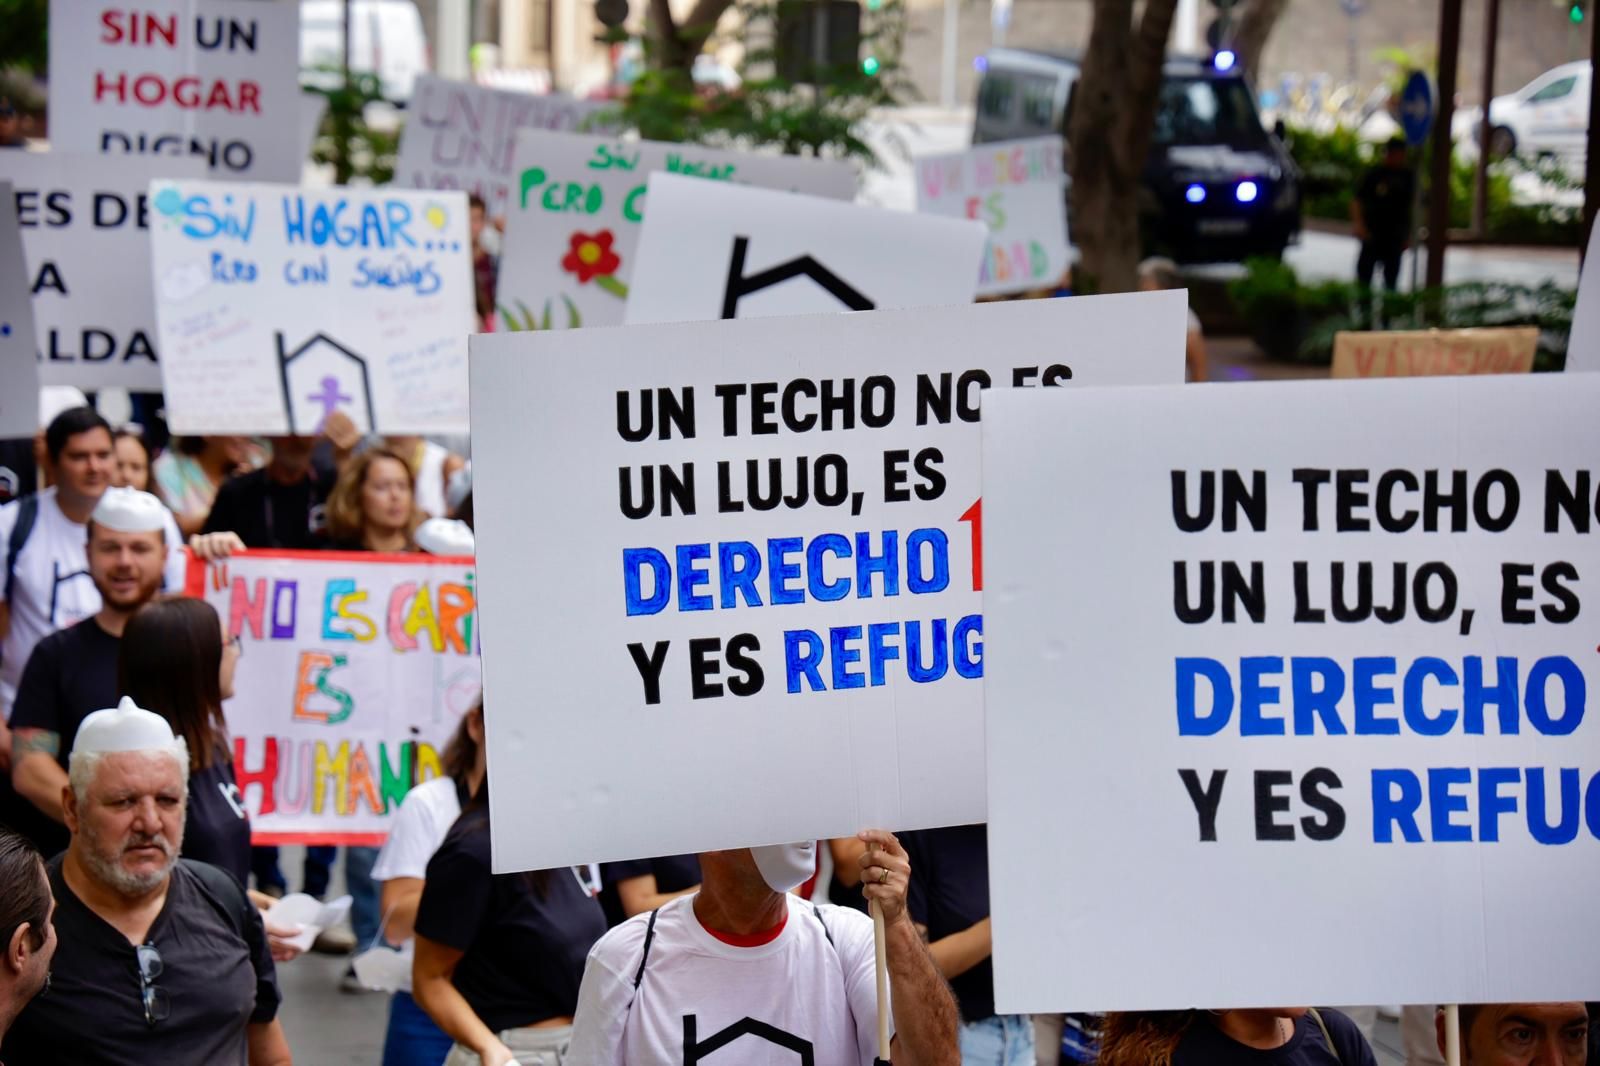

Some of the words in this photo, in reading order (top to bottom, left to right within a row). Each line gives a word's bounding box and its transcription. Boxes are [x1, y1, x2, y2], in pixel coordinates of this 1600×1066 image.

[99, 11, 177, 47] SIN
[194, 17, 257, 52] UN
[94, 73, 262, 113] HOGAR
[31, 262, 69, 296] A
[36, 328, 159, 363] LDA
[616, 386, 696, 442] UN
[715, 374, 896, 437] TECHO
[618, 462, 697, 520] UN
[717, 453, 865, 516] LUJO,
[883, 446, 947, 503] ES
[1170, 468, 1267, 533] UN
[1292, 468, 1520, 533] TECHO
[1543, 468, 1600, 534] N
[623, 527, 950, 617] DERECHO
[1173, 560, 1265, 624] UN
[1293, 561, 1475, 636] LUJO,
[1500, 561, 1581, 624] ES
[322, 578, 378, 644] ES
[293, 650, 354, 726] ES
[626, 640, 671, 705] Y
[689, 632, 765, 700] ES
[1175, 655, 1586, 736] DERECHO
[1177, 768, 1228, 842] Y
[1253, 767, 1346, 842] ES
[1371, 766, 1600, 845] REFU
